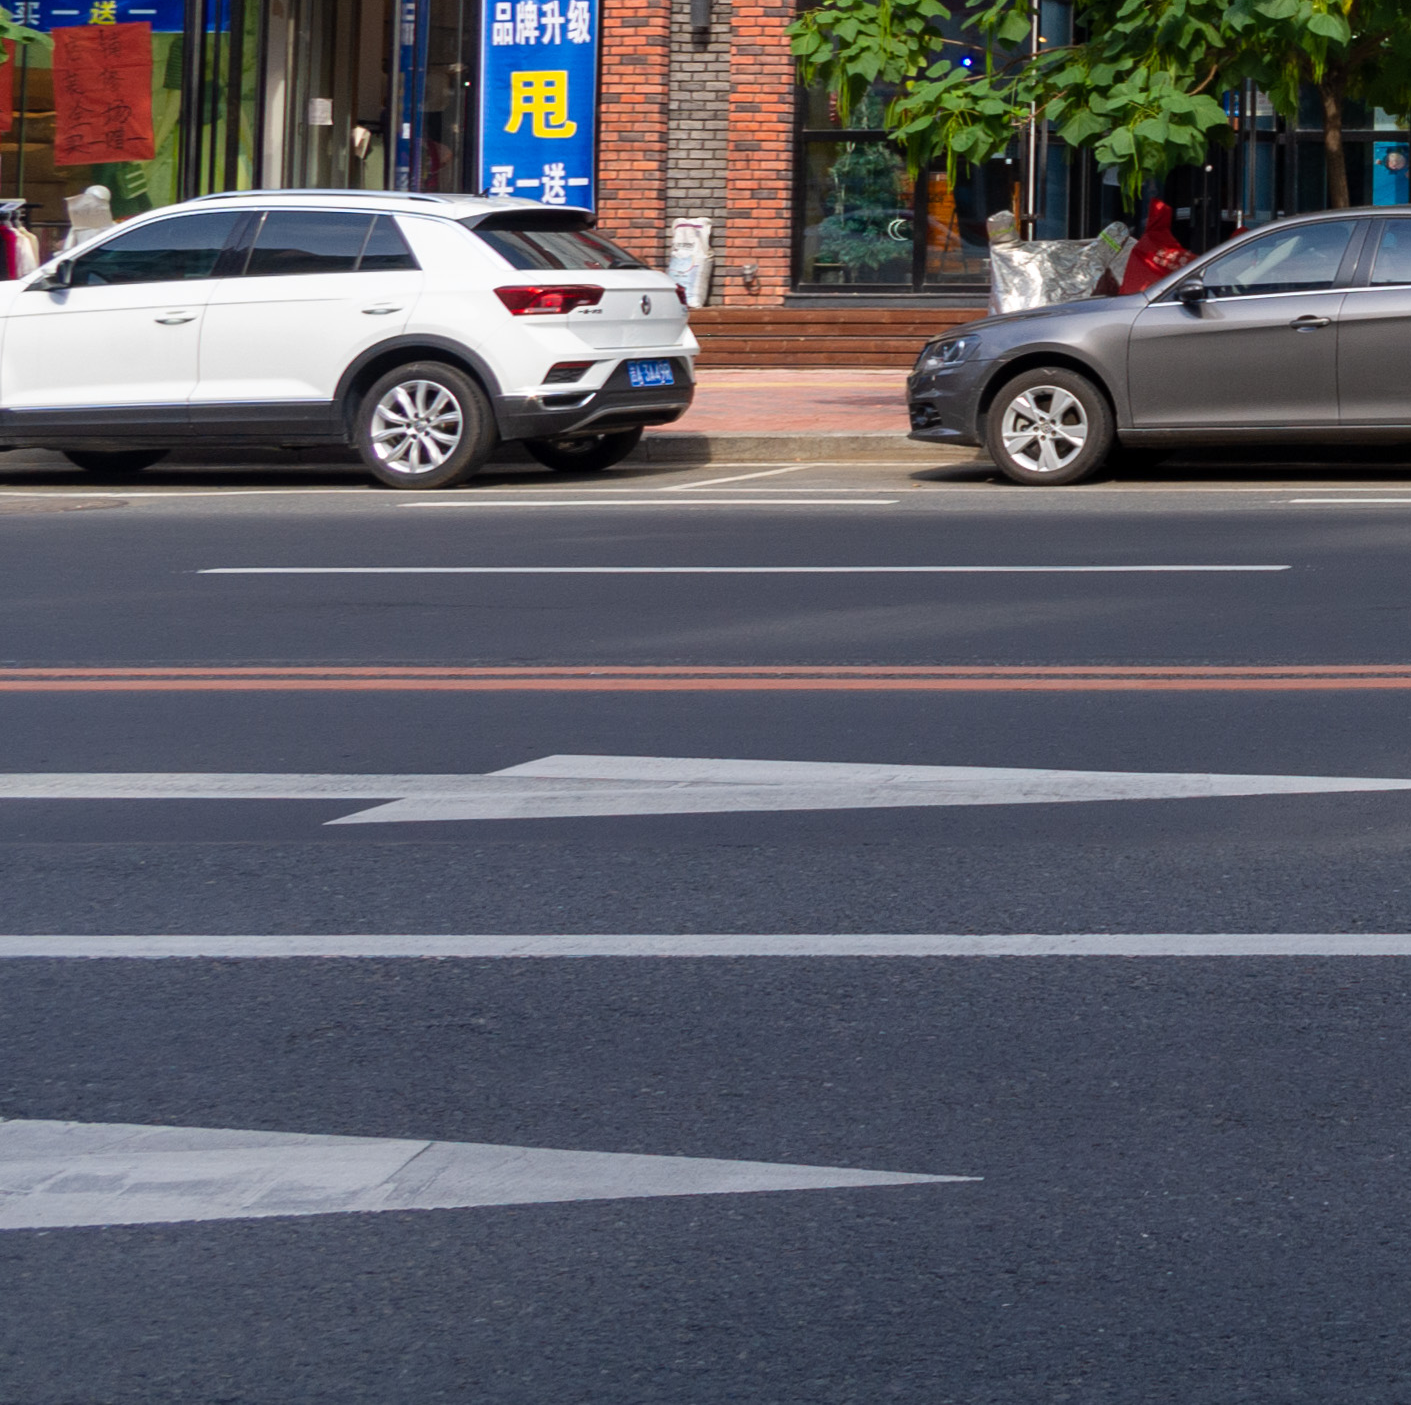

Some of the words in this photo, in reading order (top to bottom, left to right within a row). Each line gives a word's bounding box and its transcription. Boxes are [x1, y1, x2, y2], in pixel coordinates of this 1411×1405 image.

[504, 70, 578, 139] 甩
[490, 163, 590, 205] 买一送一
